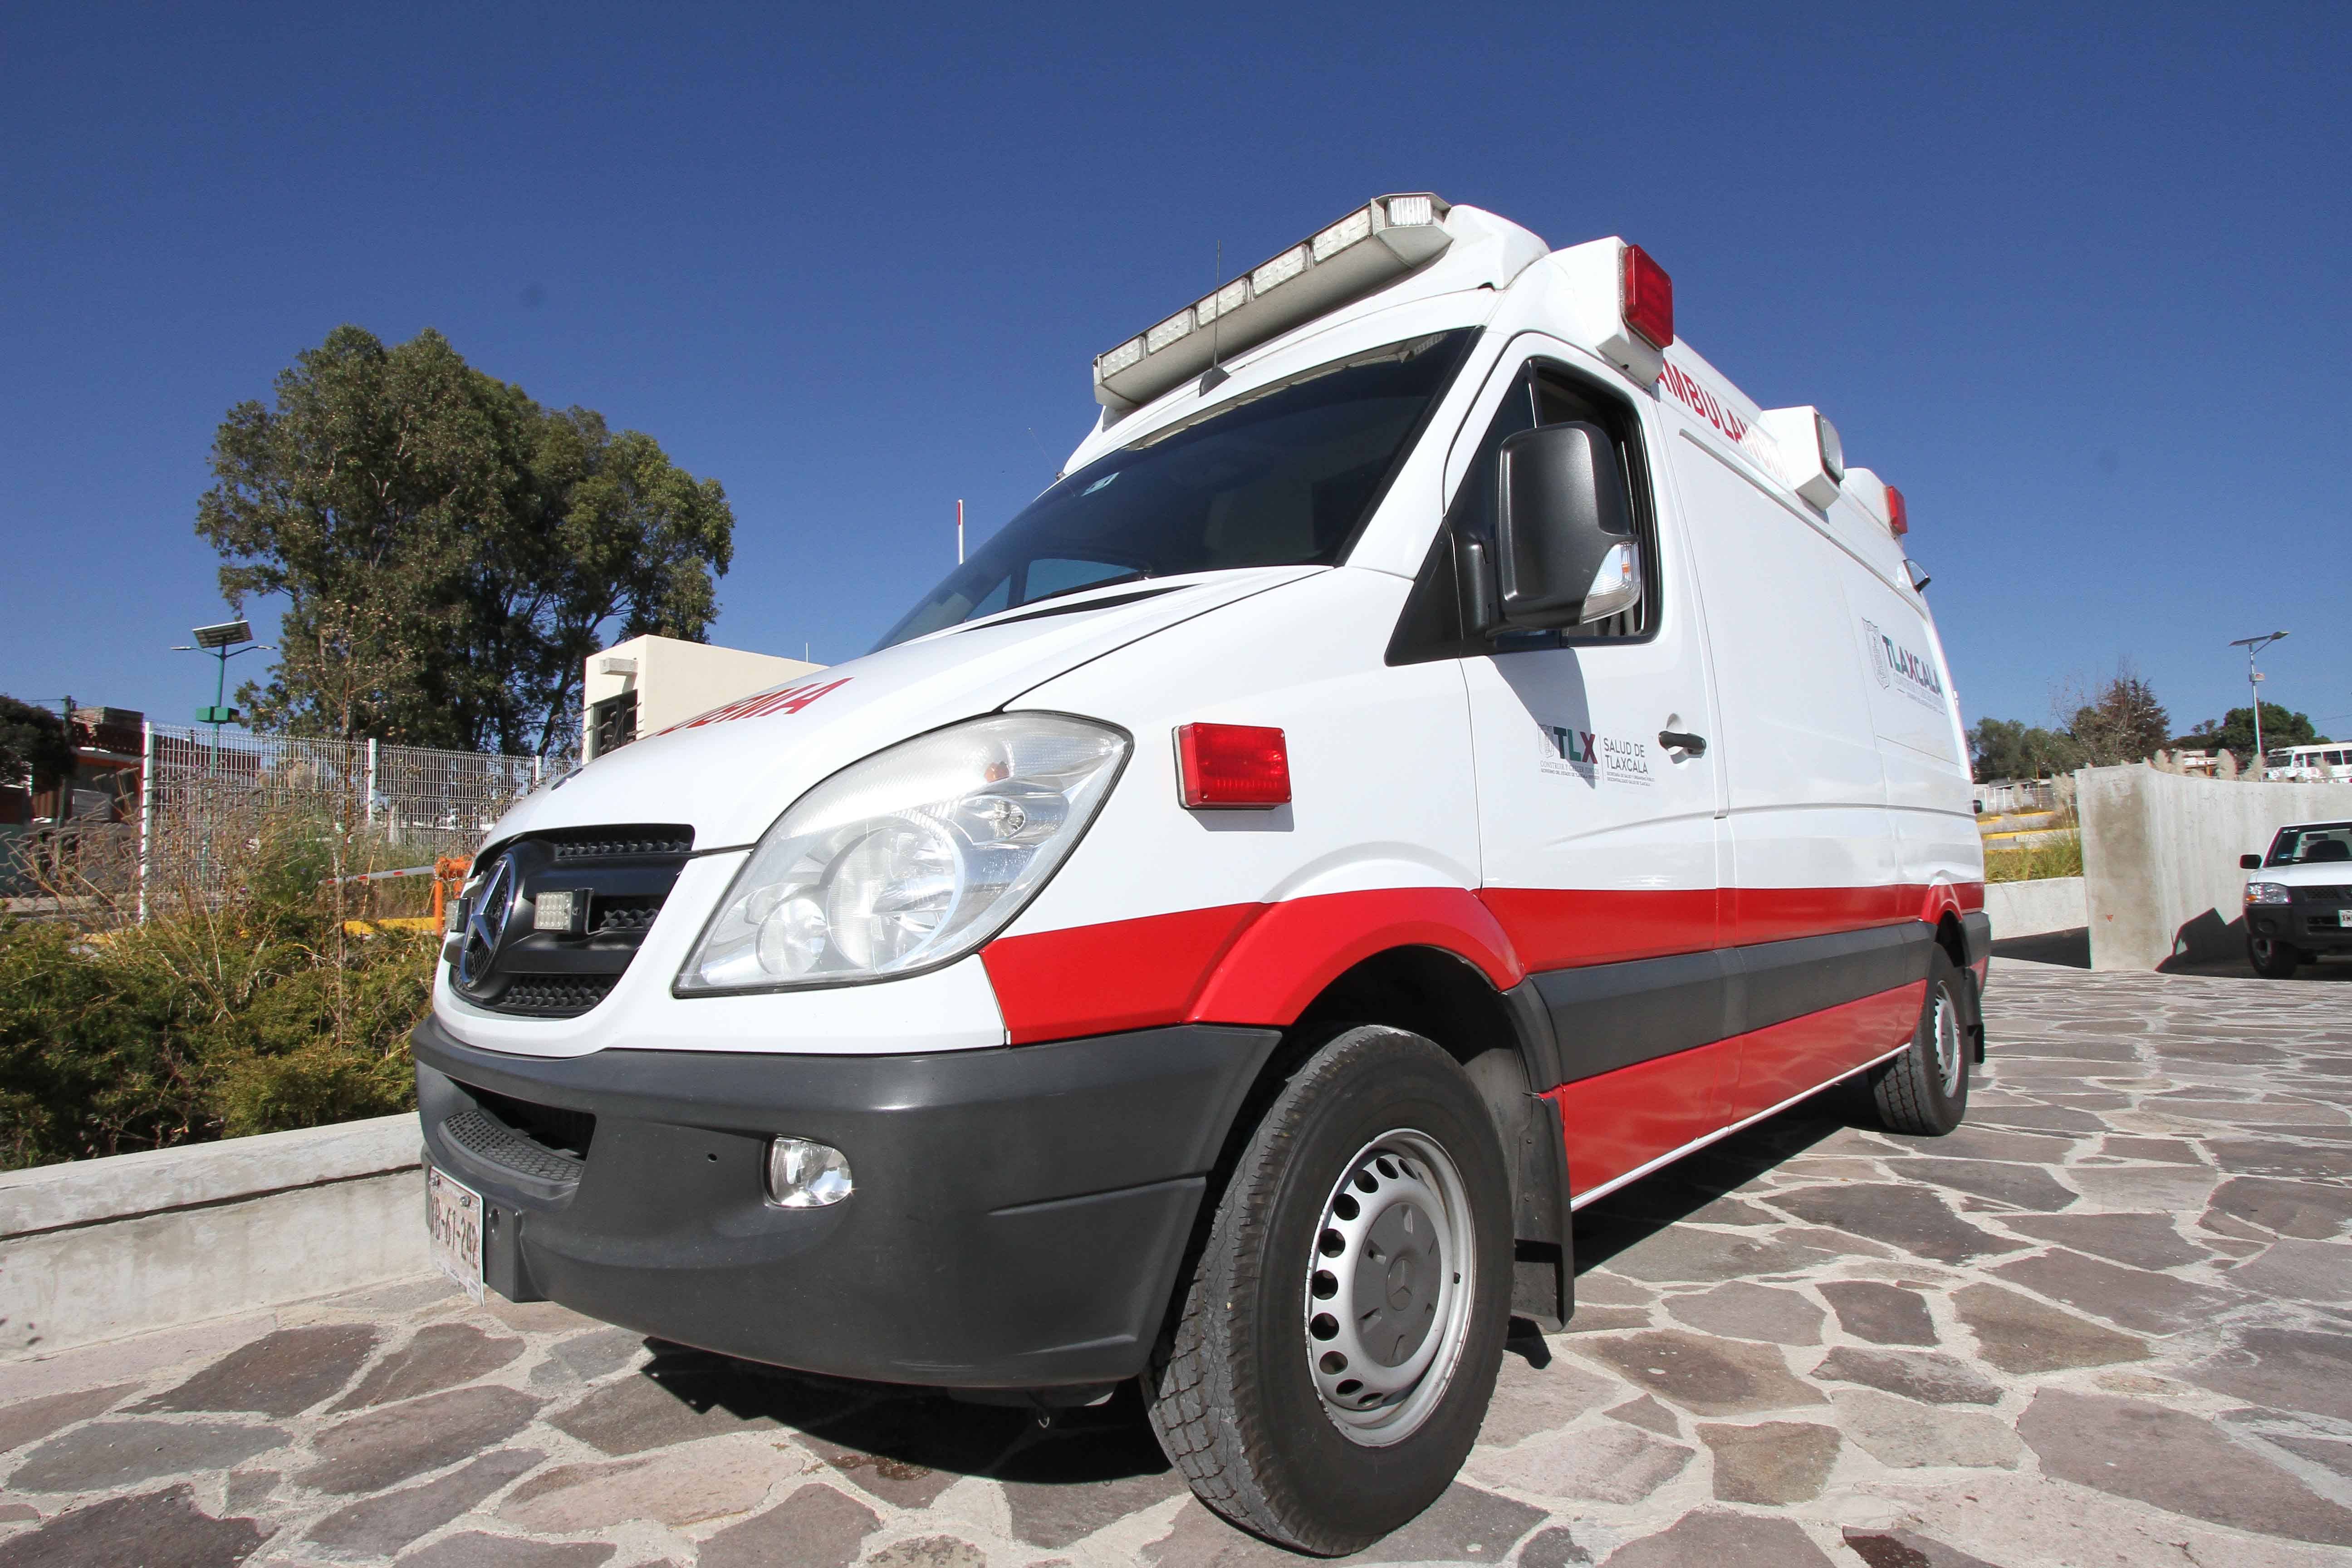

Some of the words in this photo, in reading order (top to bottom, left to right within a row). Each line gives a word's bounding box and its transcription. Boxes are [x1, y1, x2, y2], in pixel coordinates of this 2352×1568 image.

[1881, 634, 1944, 698] TLAXCALA
[1553, 726, 1598, 764] TLX
[1604, 737, 1632, 755] SALUD
[1634, 743, 1646, 758] DE
[1605, 755, 1648, 774] TLAXCALA
